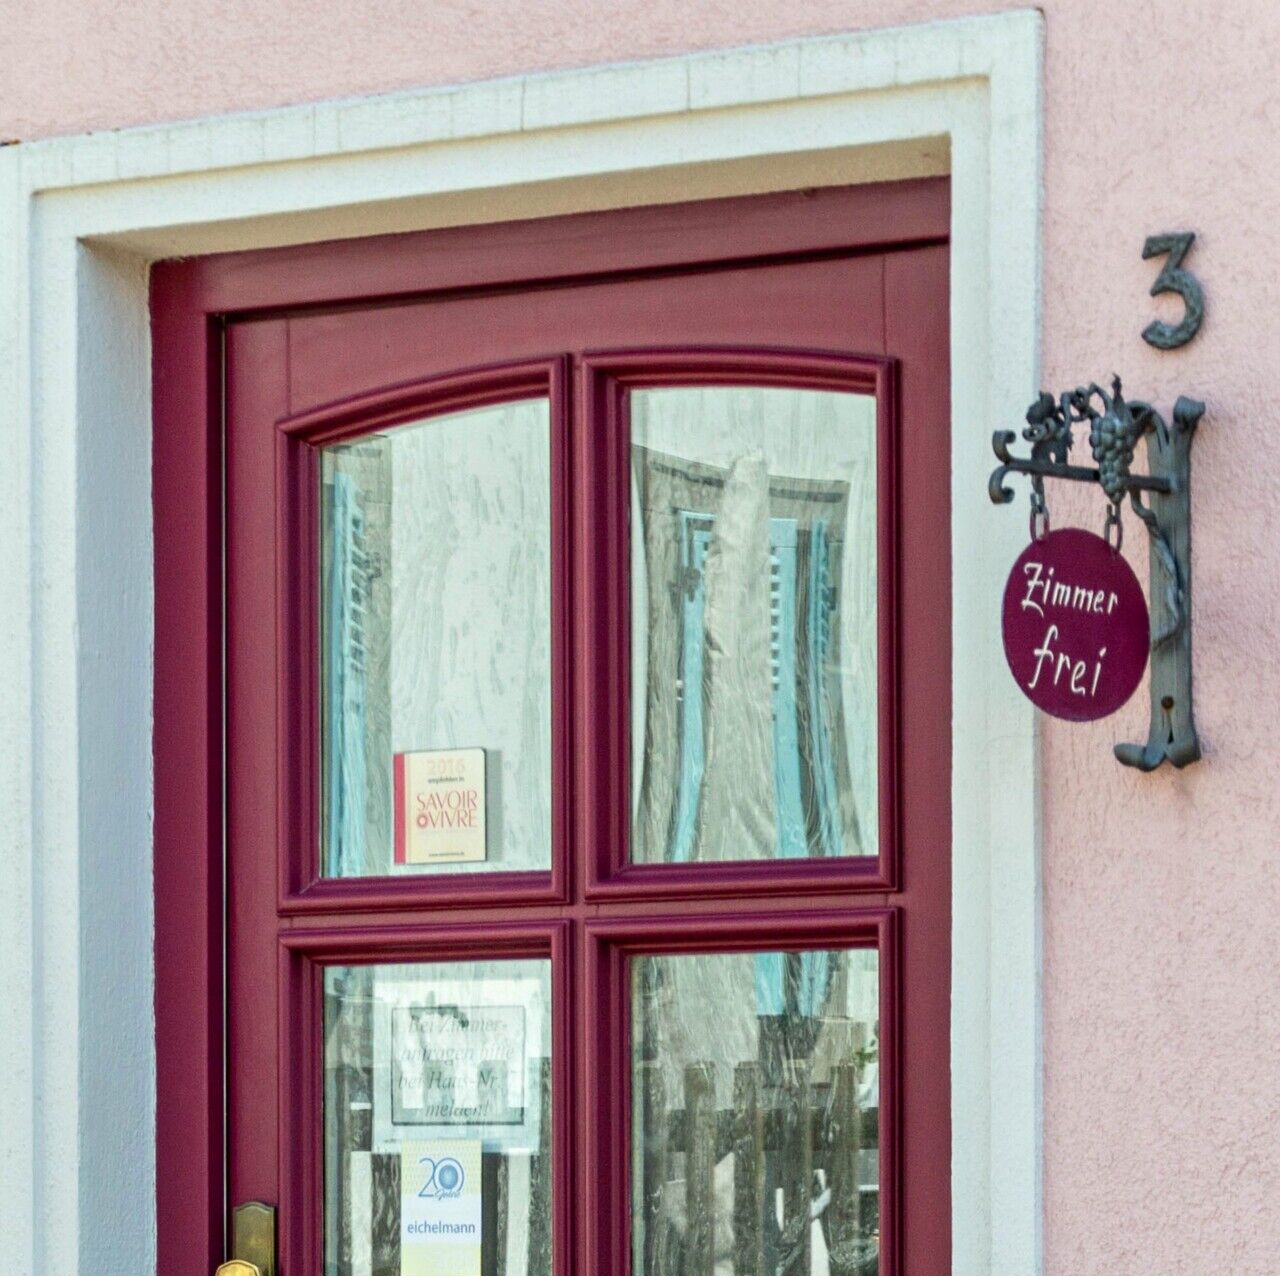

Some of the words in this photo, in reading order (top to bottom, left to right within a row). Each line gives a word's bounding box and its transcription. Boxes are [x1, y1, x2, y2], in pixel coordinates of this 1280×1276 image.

[1141, 232, 1204, 350] 3
[1020, 562, 1119, 618] Zimmer
[1028, 624, 1107, 697] frei
[416, 790, 478, 811] SAVOIR
[428, 810, 478, 828] VIVRE
[417, 1157, 465, 1198] 20
[407, 1221, 476, 1234] eichelmann
